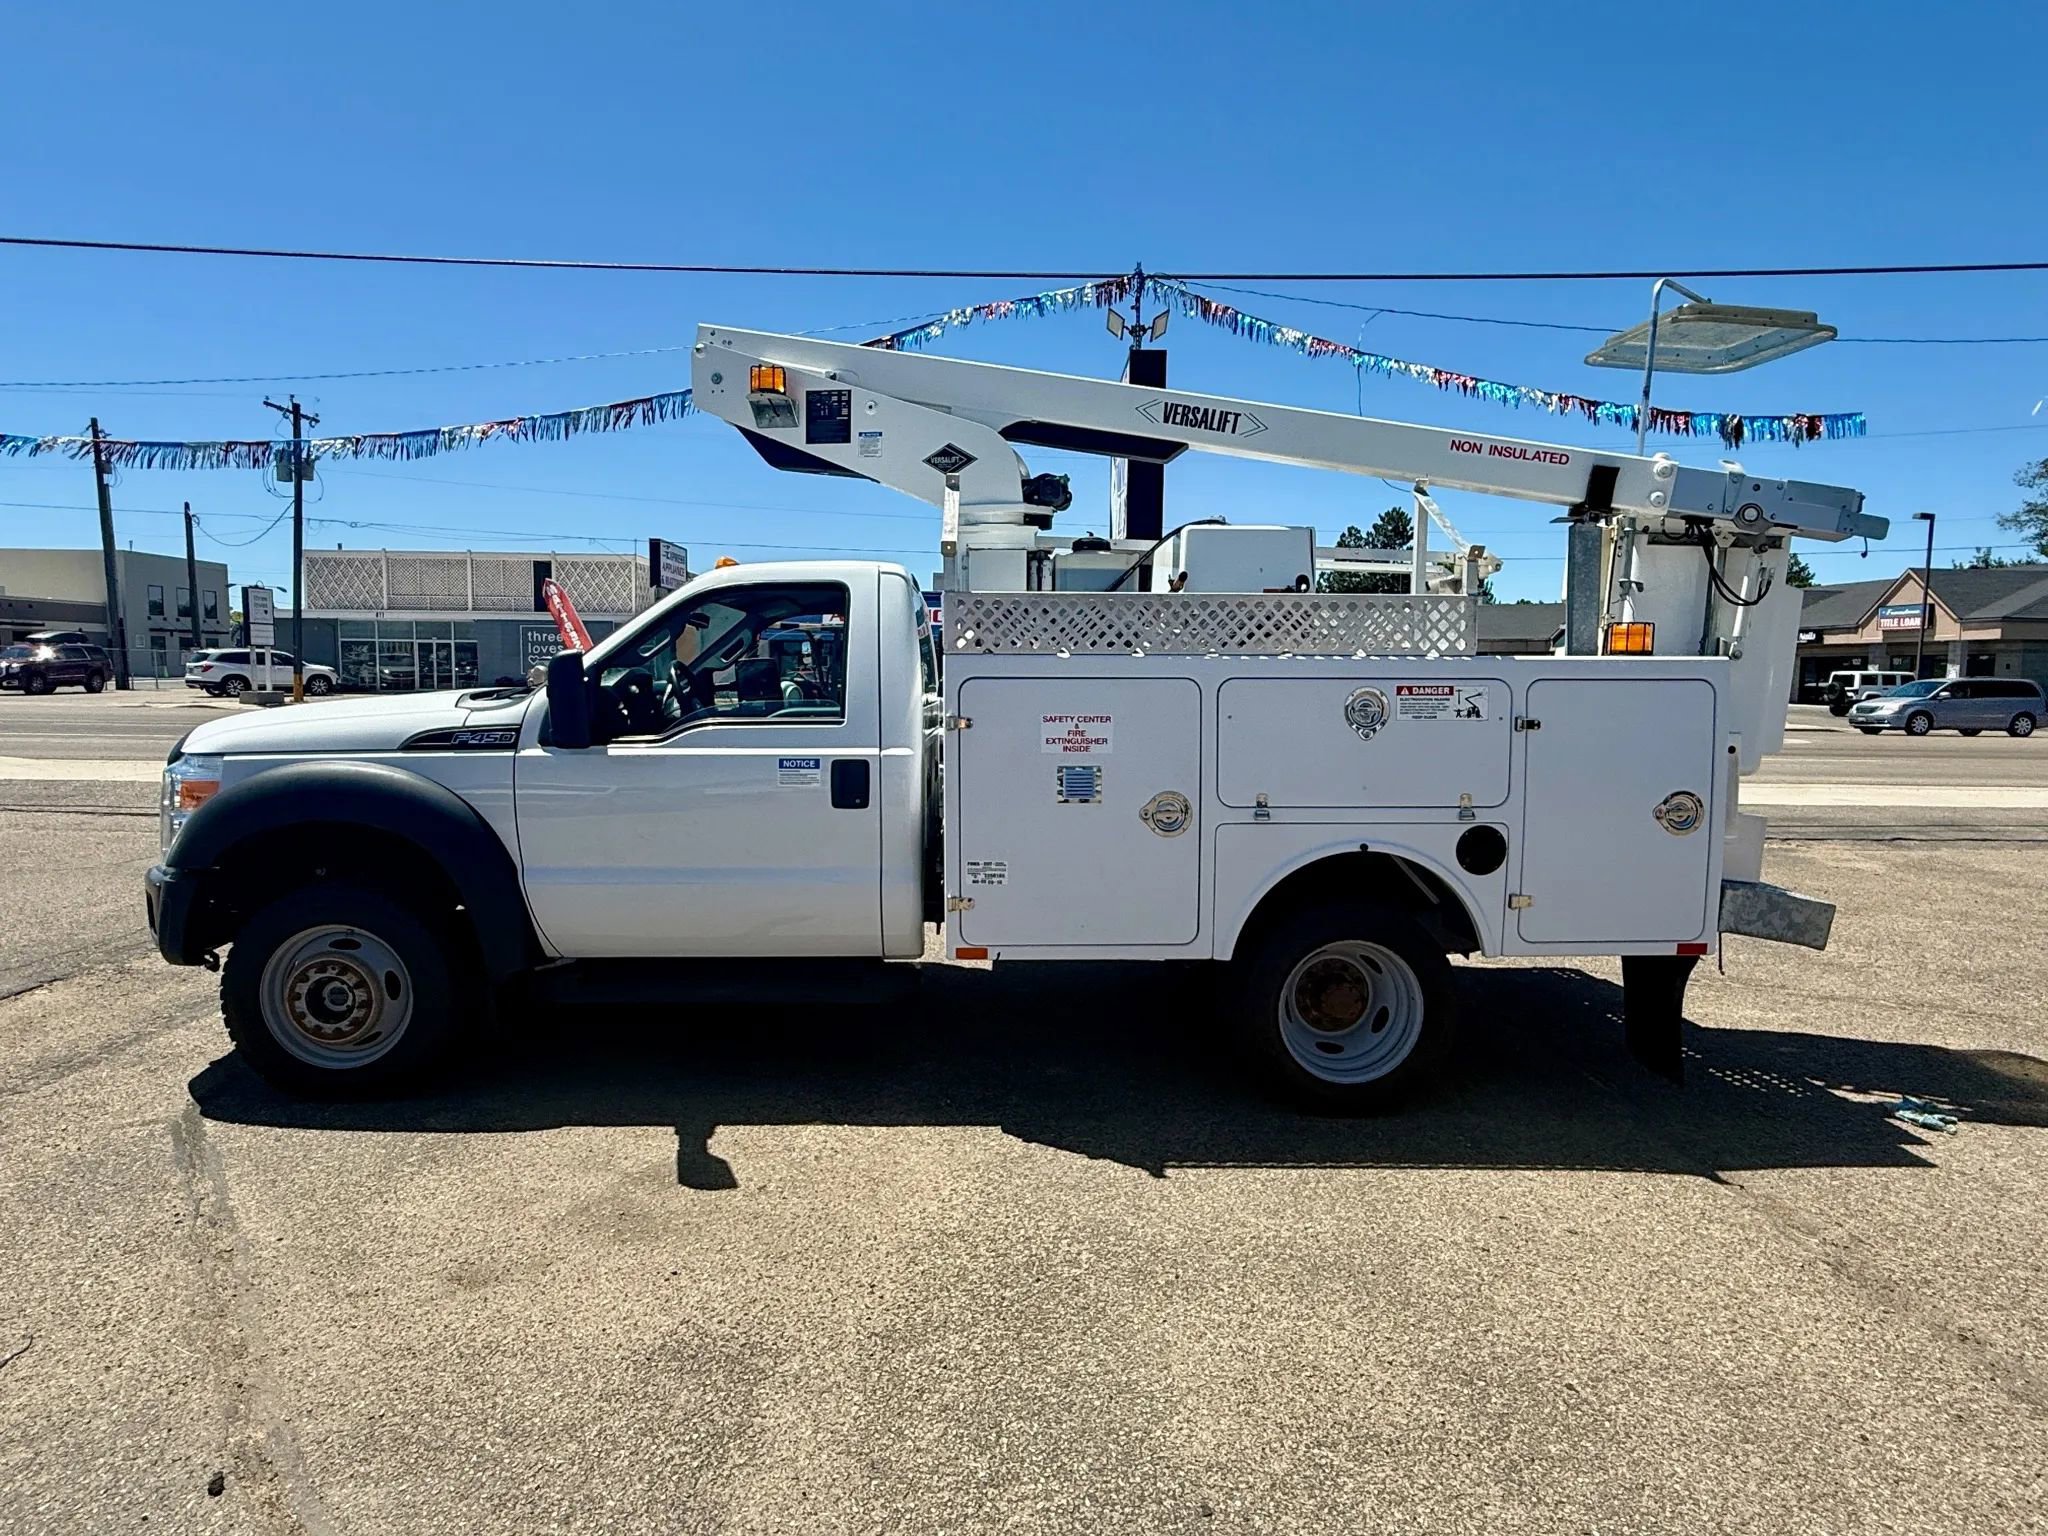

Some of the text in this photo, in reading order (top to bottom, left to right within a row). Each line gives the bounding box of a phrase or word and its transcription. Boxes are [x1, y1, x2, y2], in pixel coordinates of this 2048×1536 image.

[1163, 401, 1242, 435] VERSALIFT
[1450, 439, 1570, 465] NON INSULATED
[930, 456, 960, 465] VERSALIFT
[662, 562, 686, 578] APPLIANCE
[1880, 617, 1922, 628] TITLE LOAN
[527, 631, 564, 642] three
[527, 643, 564, 654] loves
[1412, 687, 1450, 695] DANGER
[1042, 715, 1111, 723] SAFETY CENTER
[451, 731, 517, 744] F-450
[1045, 737, 1108, 745] EXTINGUISHER
[1062, 745, 1091, 753] INSIDE
[782, 759, 816, 768] NOTICE
